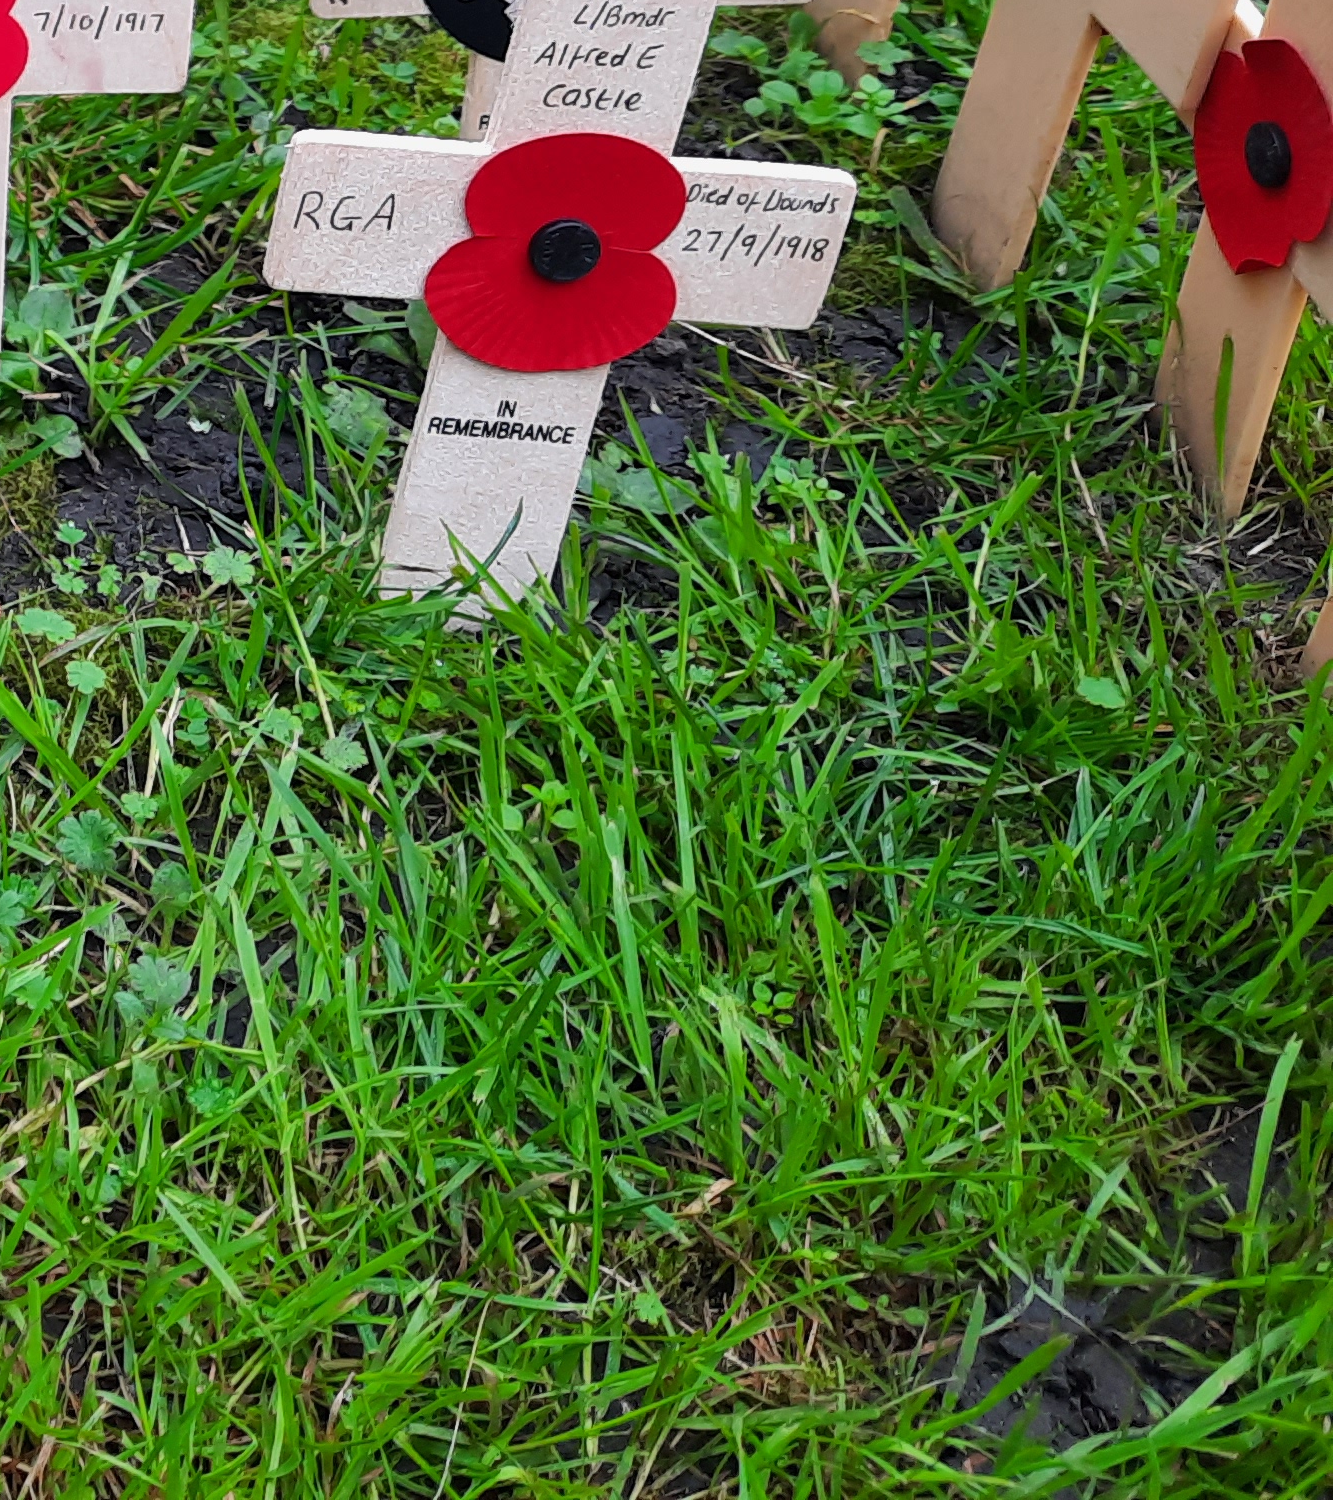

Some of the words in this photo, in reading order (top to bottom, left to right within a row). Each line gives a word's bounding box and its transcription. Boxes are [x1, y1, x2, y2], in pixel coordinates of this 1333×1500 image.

[33, 4, 165, 40] 7/10/1917
[573, 0, 676, 30] L/Bmdr
[534, 40, 632, 70] Alfred
[636, 44, 665, 69] E
[543, 83, 642, 112] Castle
[293, 190, 397, 232] RGA
[686, 182, 735, 207] Died
[736, 190, 761, 215] of
[681, 223, 830, 267] 27/9/1918
[497, 399, 516, 419] IN
[427, 417, 576, 445] REMEMBRANCE
